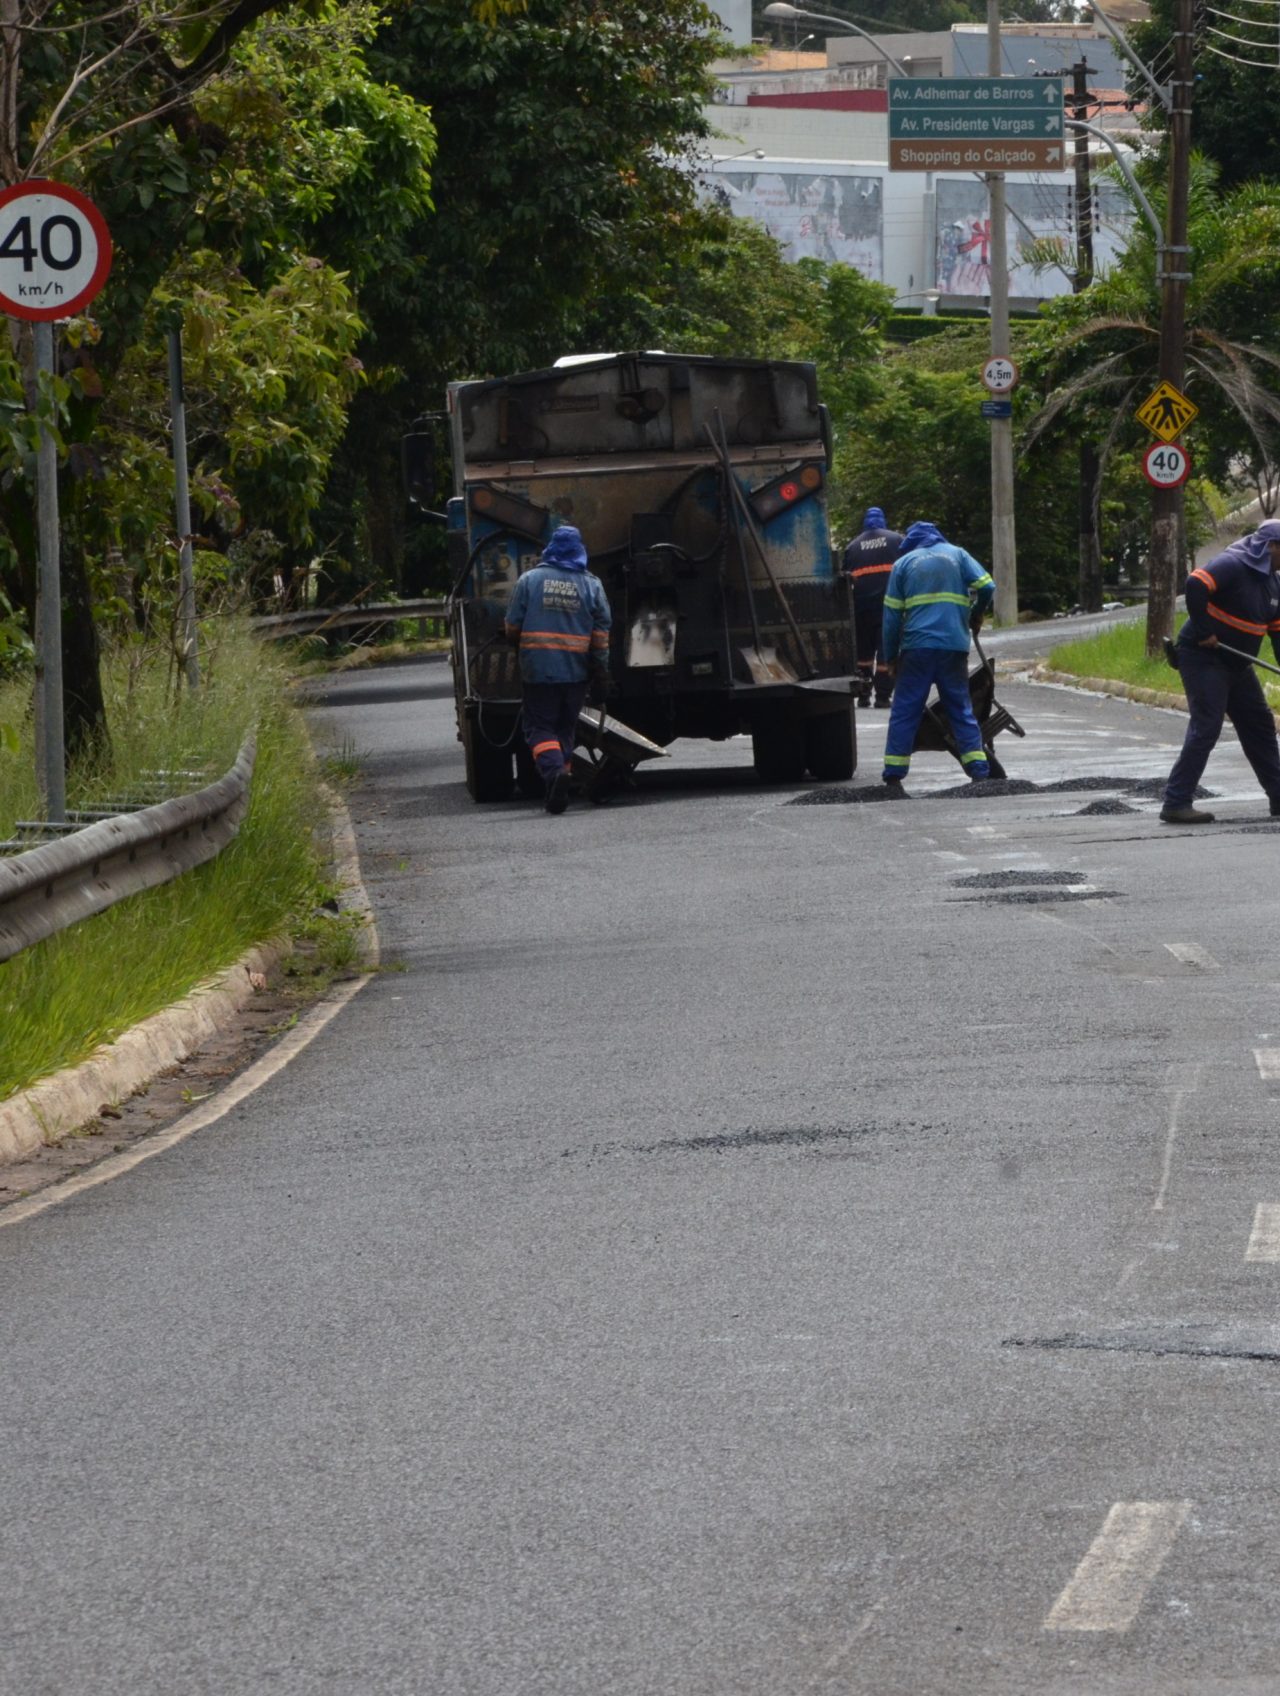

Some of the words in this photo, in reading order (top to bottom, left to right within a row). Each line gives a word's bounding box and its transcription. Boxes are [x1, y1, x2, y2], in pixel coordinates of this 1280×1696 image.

[893, 87, 911, 100] Av.
[914, 87, 970, 100] Adhemar
[973, 87, 989, 100] de
[992, 87, 1034, 100] Barros
[901, 118, 919, 130] Av.
[923, 118, 988, 131] Presidente
[992, 118, 1035, 133] Vargas
[900, 150, 961, 165] Shopping
[964, 150, 981, 162] do
[984, 149, 1036, 165] Calçado
[0, 215, 82, 272] 40
[18, 281, 64, 296] km/h
[986, 369, 1012, 380] 4,5m
[1152, 451, 1180, 471] 40
